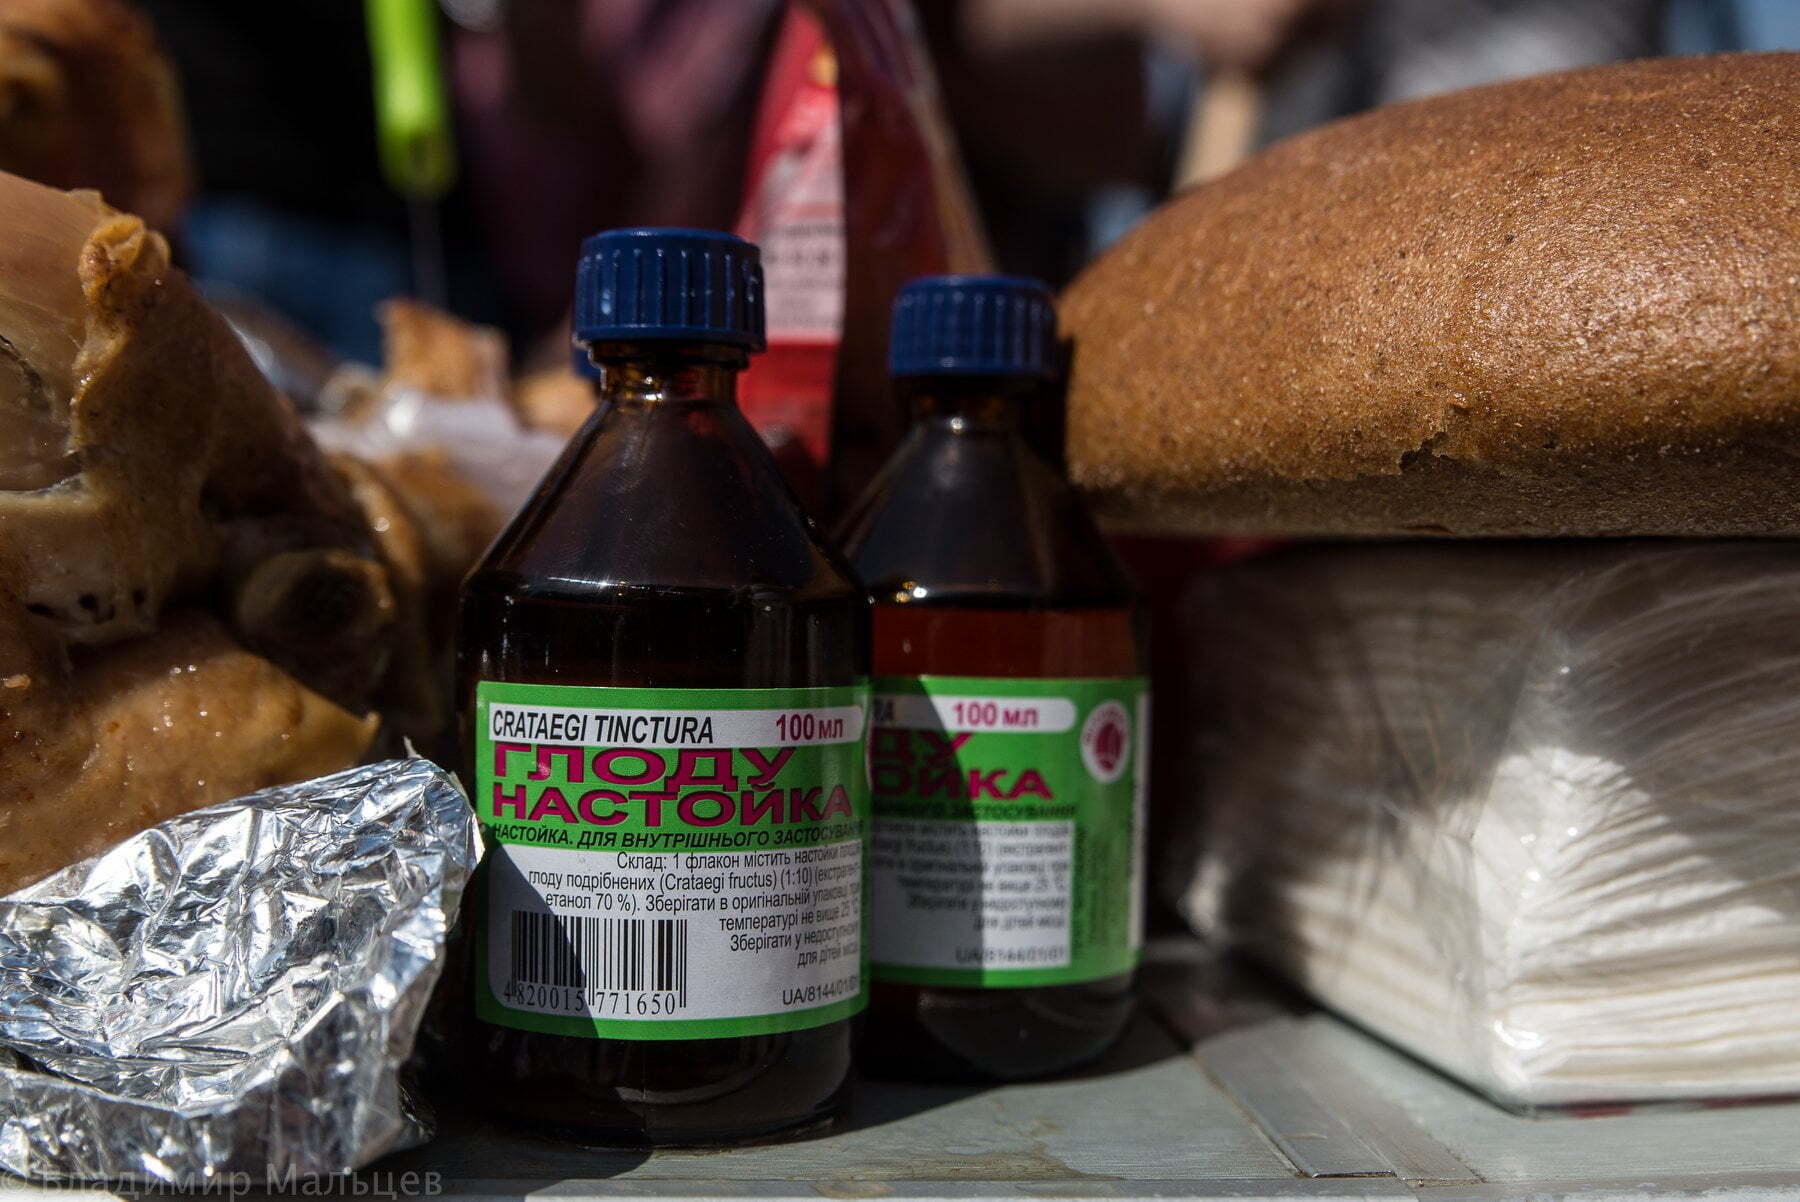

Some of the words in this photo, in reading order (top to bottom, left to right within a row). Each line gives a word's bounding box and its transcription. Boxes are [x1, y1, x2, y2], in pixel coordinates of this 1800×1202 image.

[492, 709, 588, 742] CRATAEGI
[594, 715, 714, 744] TINCTURA
[775, 713, 815, 742] 100
[818, 718, 844, 739] мл
[953, 702, 998, 727] 100
[1001, 709, 1040, 728] мл
[494, 741, 798, 793] ГЛОДУ
[492, 780, 854, 828] НАСТОЙКА
[494, 825, 574, 845] НАСТОЙКА.
[576, 830, 618, 850] ДЛЯ
[621, 831, 770, 849] ВНУТРІШНЬОГО
[616, 851, 667, 873] Склад:
[673, 852, 680, 870] 1
[685, 851, 740, 874] флакон
[743, 850, 791, 868] містить
[528, 870, 563, 890] глоду
[566, 872, 655, 893] подрібнених
[659, 873, 725, 895] (Crataegi
[728, 870, 777, 891] fructus)
[780, 866, 813, 891] (1:10)
[545, 893, 592, 910] етанол
[595, 893, 613, 911] 70
[645, 894, 715, 916] Зберігати
[719, 897, 729, 911] в
[731, 887, 810, 914] оригінальній
[719, 908, 799, 932] температурі
[801, 909, 815, 925] не
[730, 932, 792, 956] Зберігати
[795, 932, 803, 951] у
[796, 950, 818, 969] для
